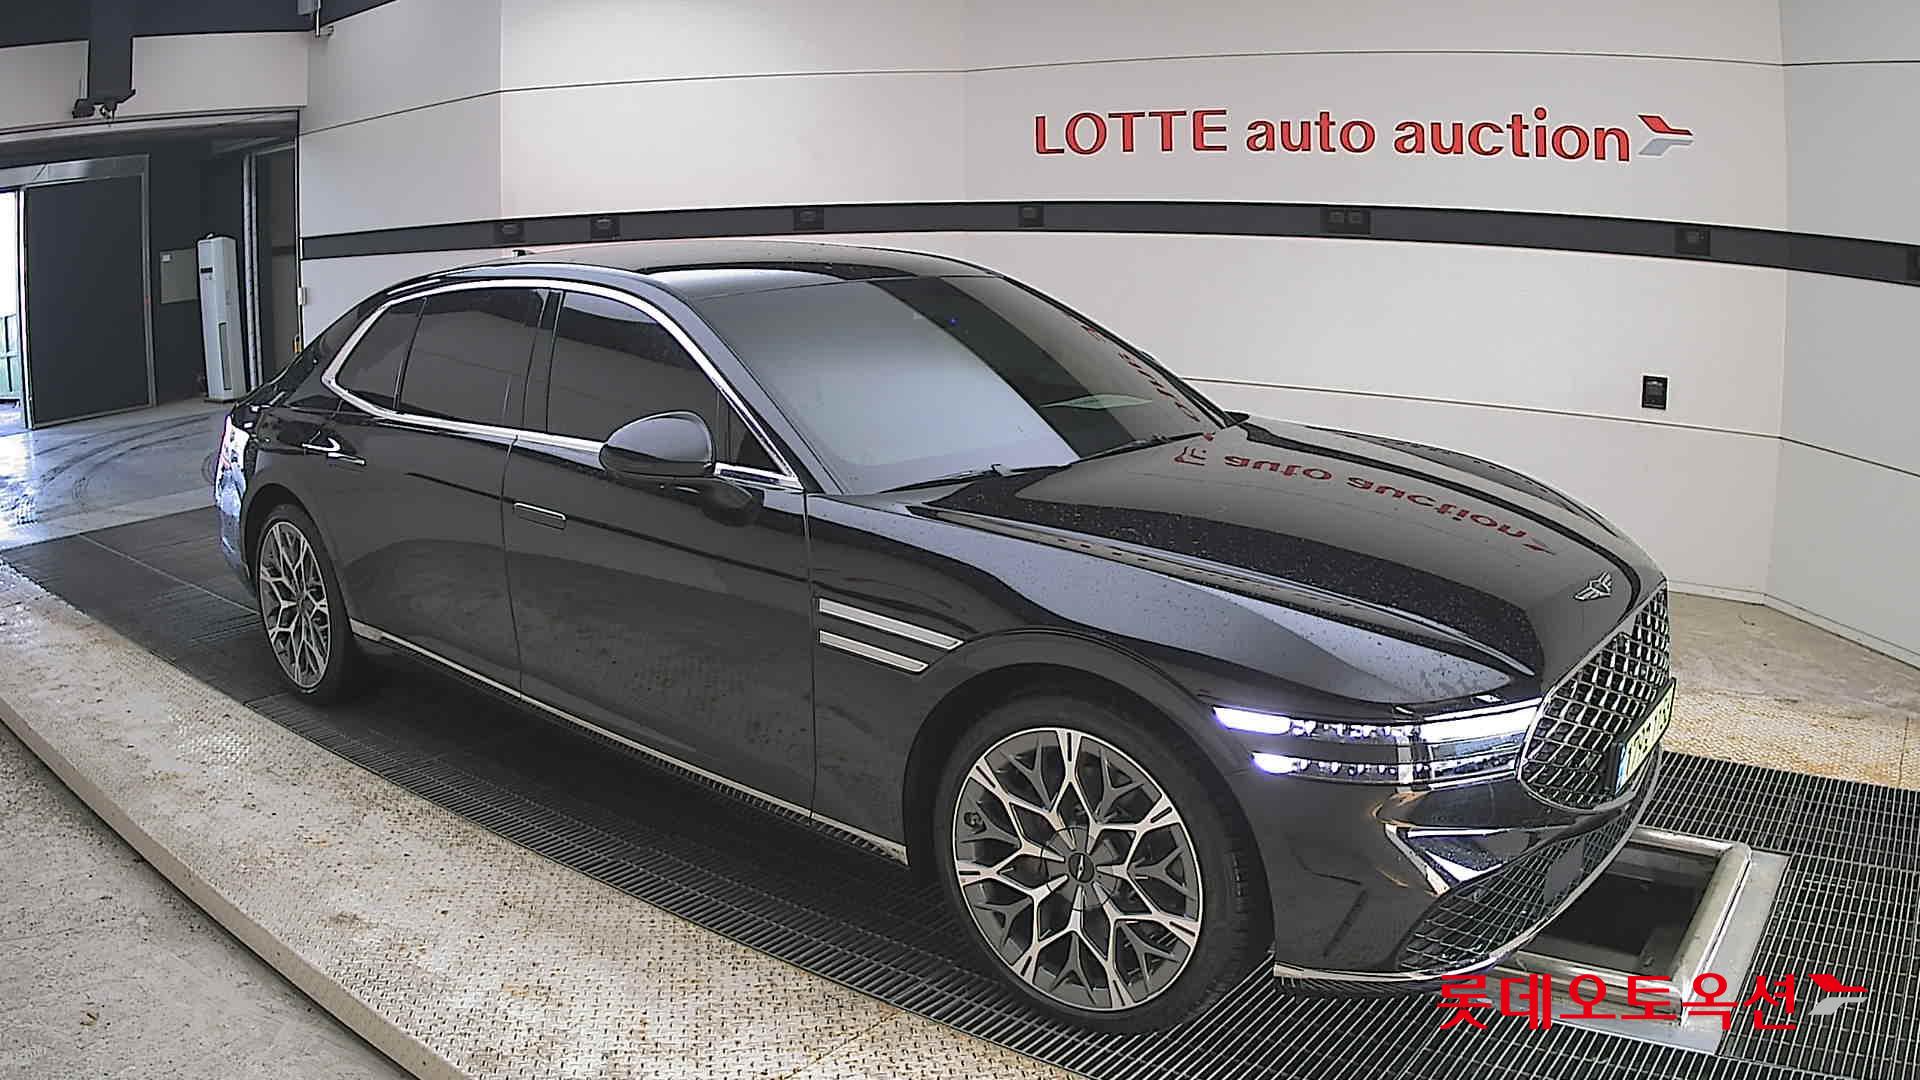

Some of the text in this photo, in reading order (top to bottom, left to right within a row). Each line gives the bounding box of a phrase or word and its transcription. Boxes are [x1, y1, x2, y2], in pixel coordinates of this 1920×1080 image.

[1034, 106, 1630, 162] LOTTE auto auction
